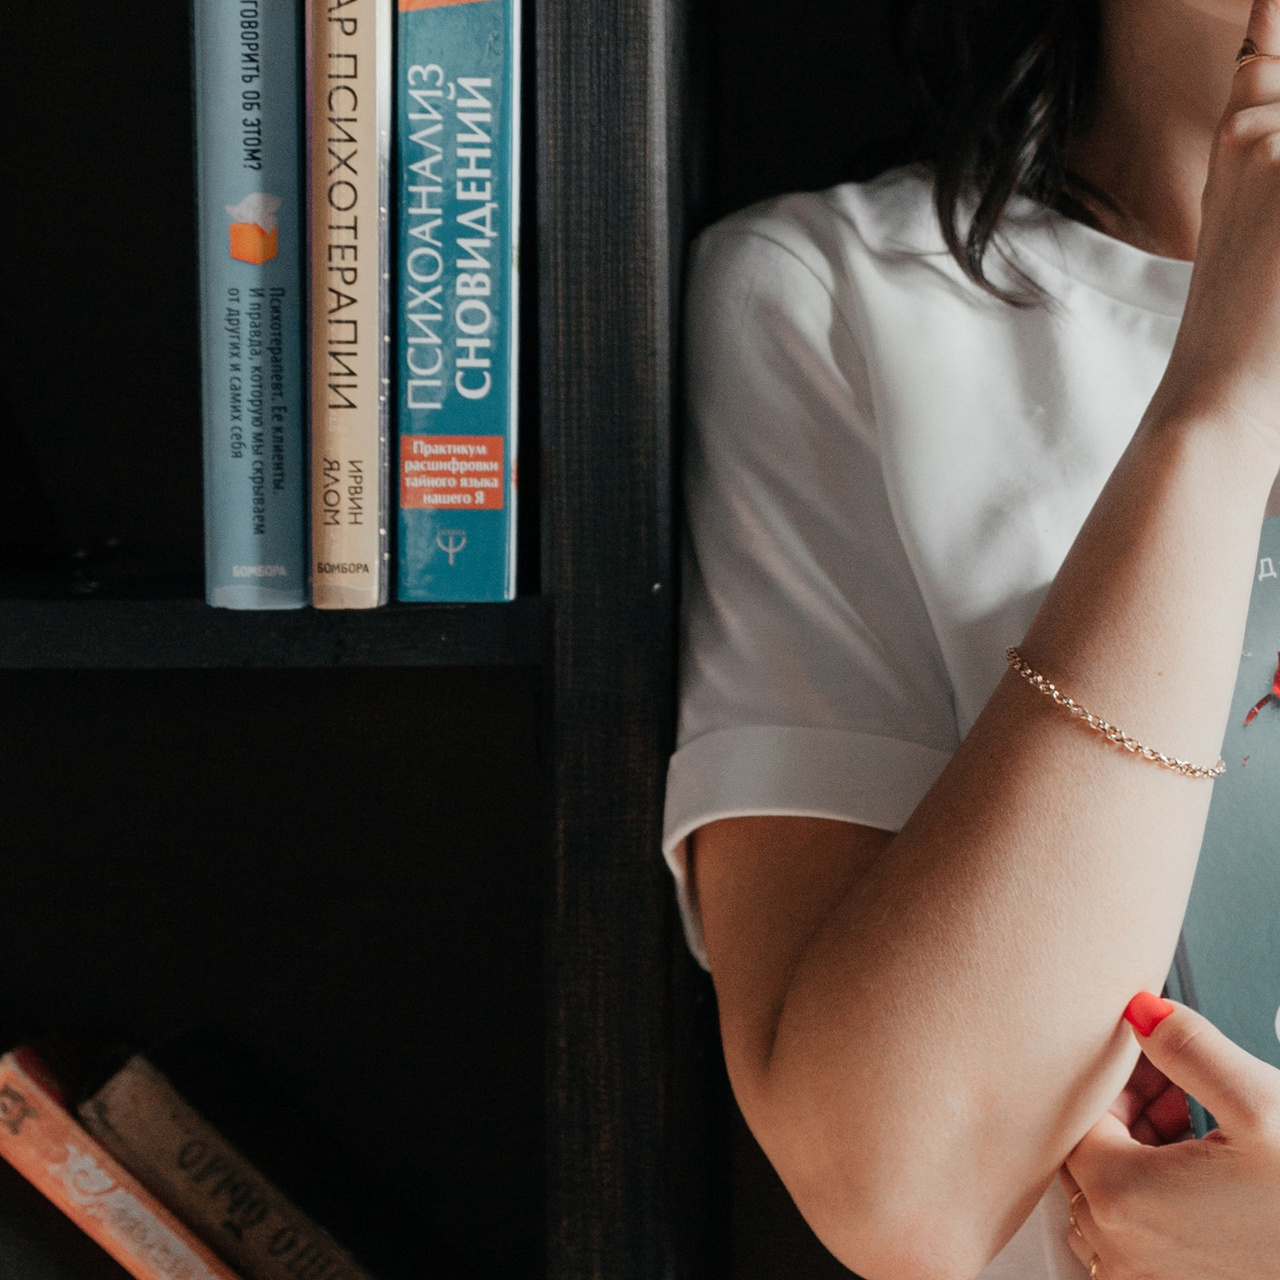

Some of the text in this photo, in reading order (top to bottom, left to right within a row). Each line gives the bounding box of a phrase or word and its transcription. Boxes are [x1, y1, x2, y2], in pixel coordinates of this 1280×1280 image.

[242, 89, 261, 112] ОБ
[242, 118, 263, 171] ЭТОМ?
[327, 51, 358, 411] ПСИХОТЕРАПИИ
[406, 63, 444, 410] ПСИХОАНАЛИЗ
[447, 77, 499, 401] СНОВИДЕНИЙ
[223, 287, 247, 459] от других и самих себя
[245, 287, 266, 535] И правда, которую мы скрываем
[404, 457, 499, 475] расшифровки
[412, 439, 488, 457] Практикум
[322, 457, 341, 526] ЯЛОМ
[347, 460, 364, 526] ИРВИН
[404, 475, 499, 489] тайного языка
[422, 490, 486, 505] нашего Я
[317, 561, 370, 575] БОМБОРА
